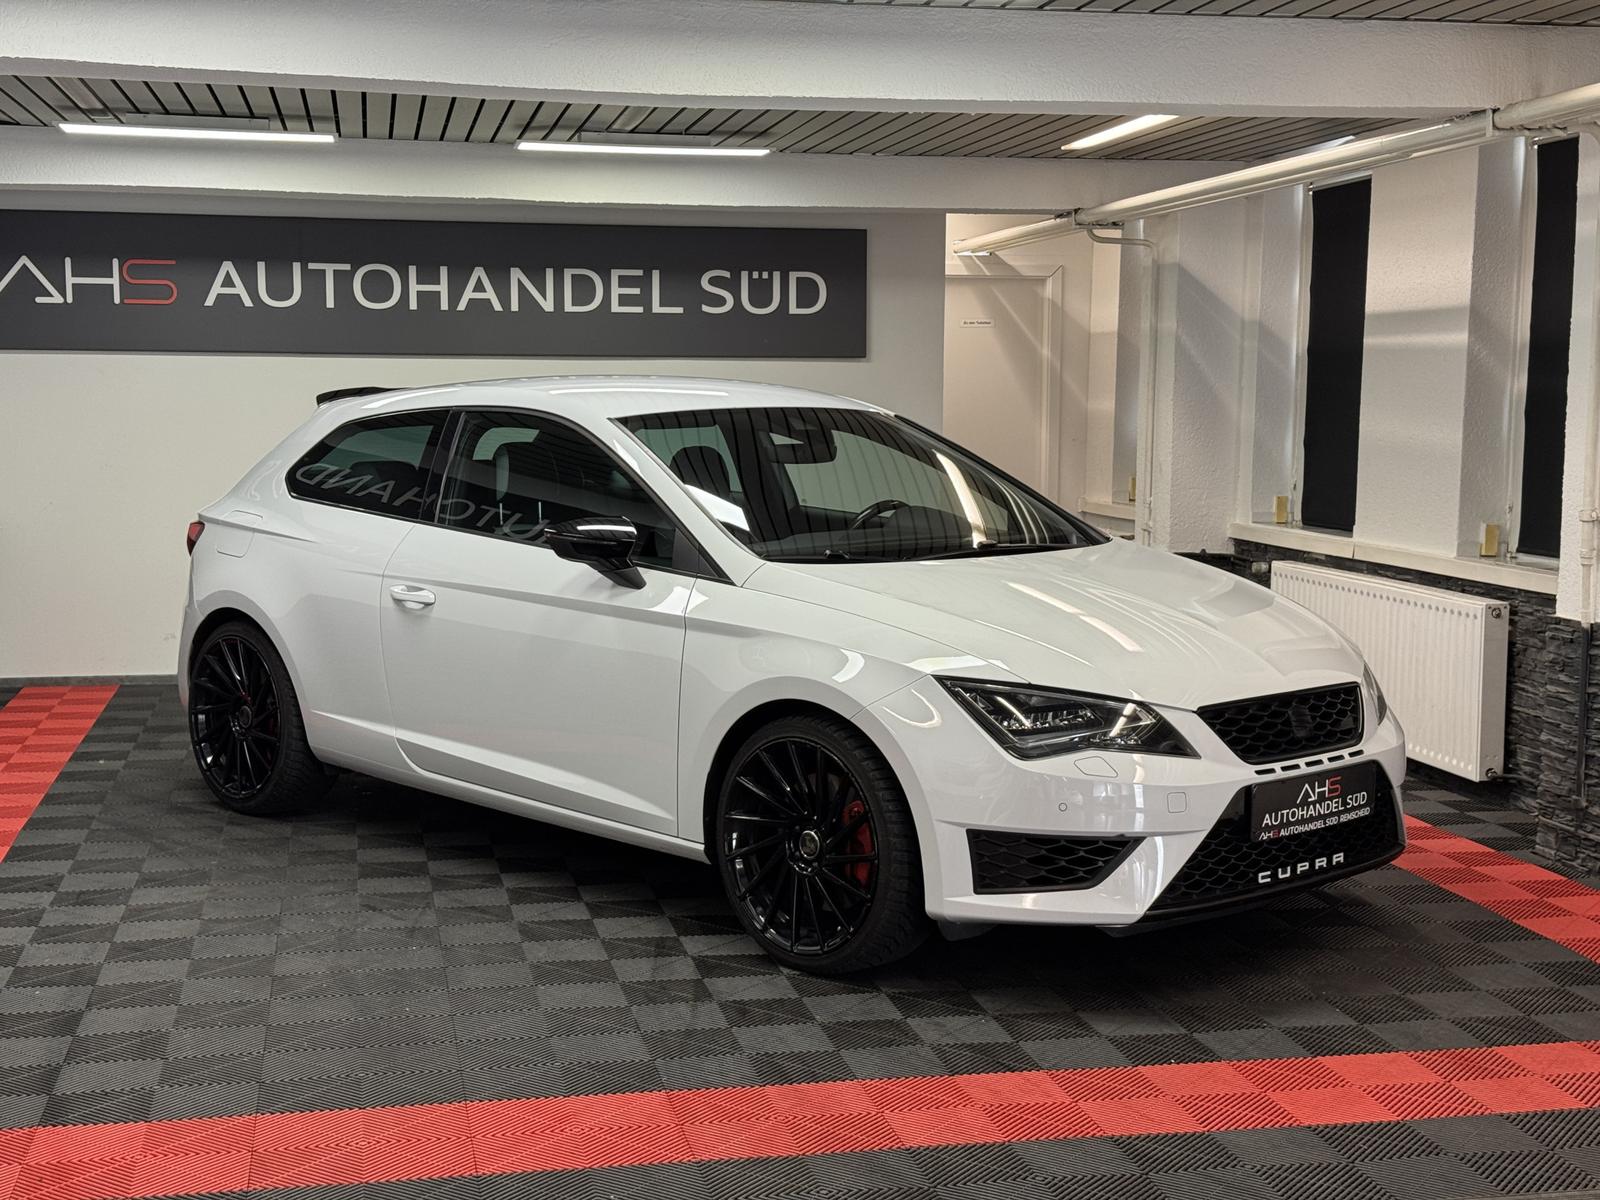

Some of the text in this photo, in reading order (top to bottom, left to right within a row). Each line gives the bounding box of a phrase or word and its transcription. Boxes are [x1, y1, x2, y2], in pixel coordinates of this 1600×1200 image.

[0, 255, 828, 316] AHS AUTOHANDEL SÜD
[1296, 776, 1342, 804] AHS
[1262, 791, 1368, 828] AUTOHANDEL SÜD
[1279, 820, 1327, 837] AUTOHANDEL
[1340, 806, 1371, 823] REMSCHEID
[1258, 852, 1345, 884] CUPRA
